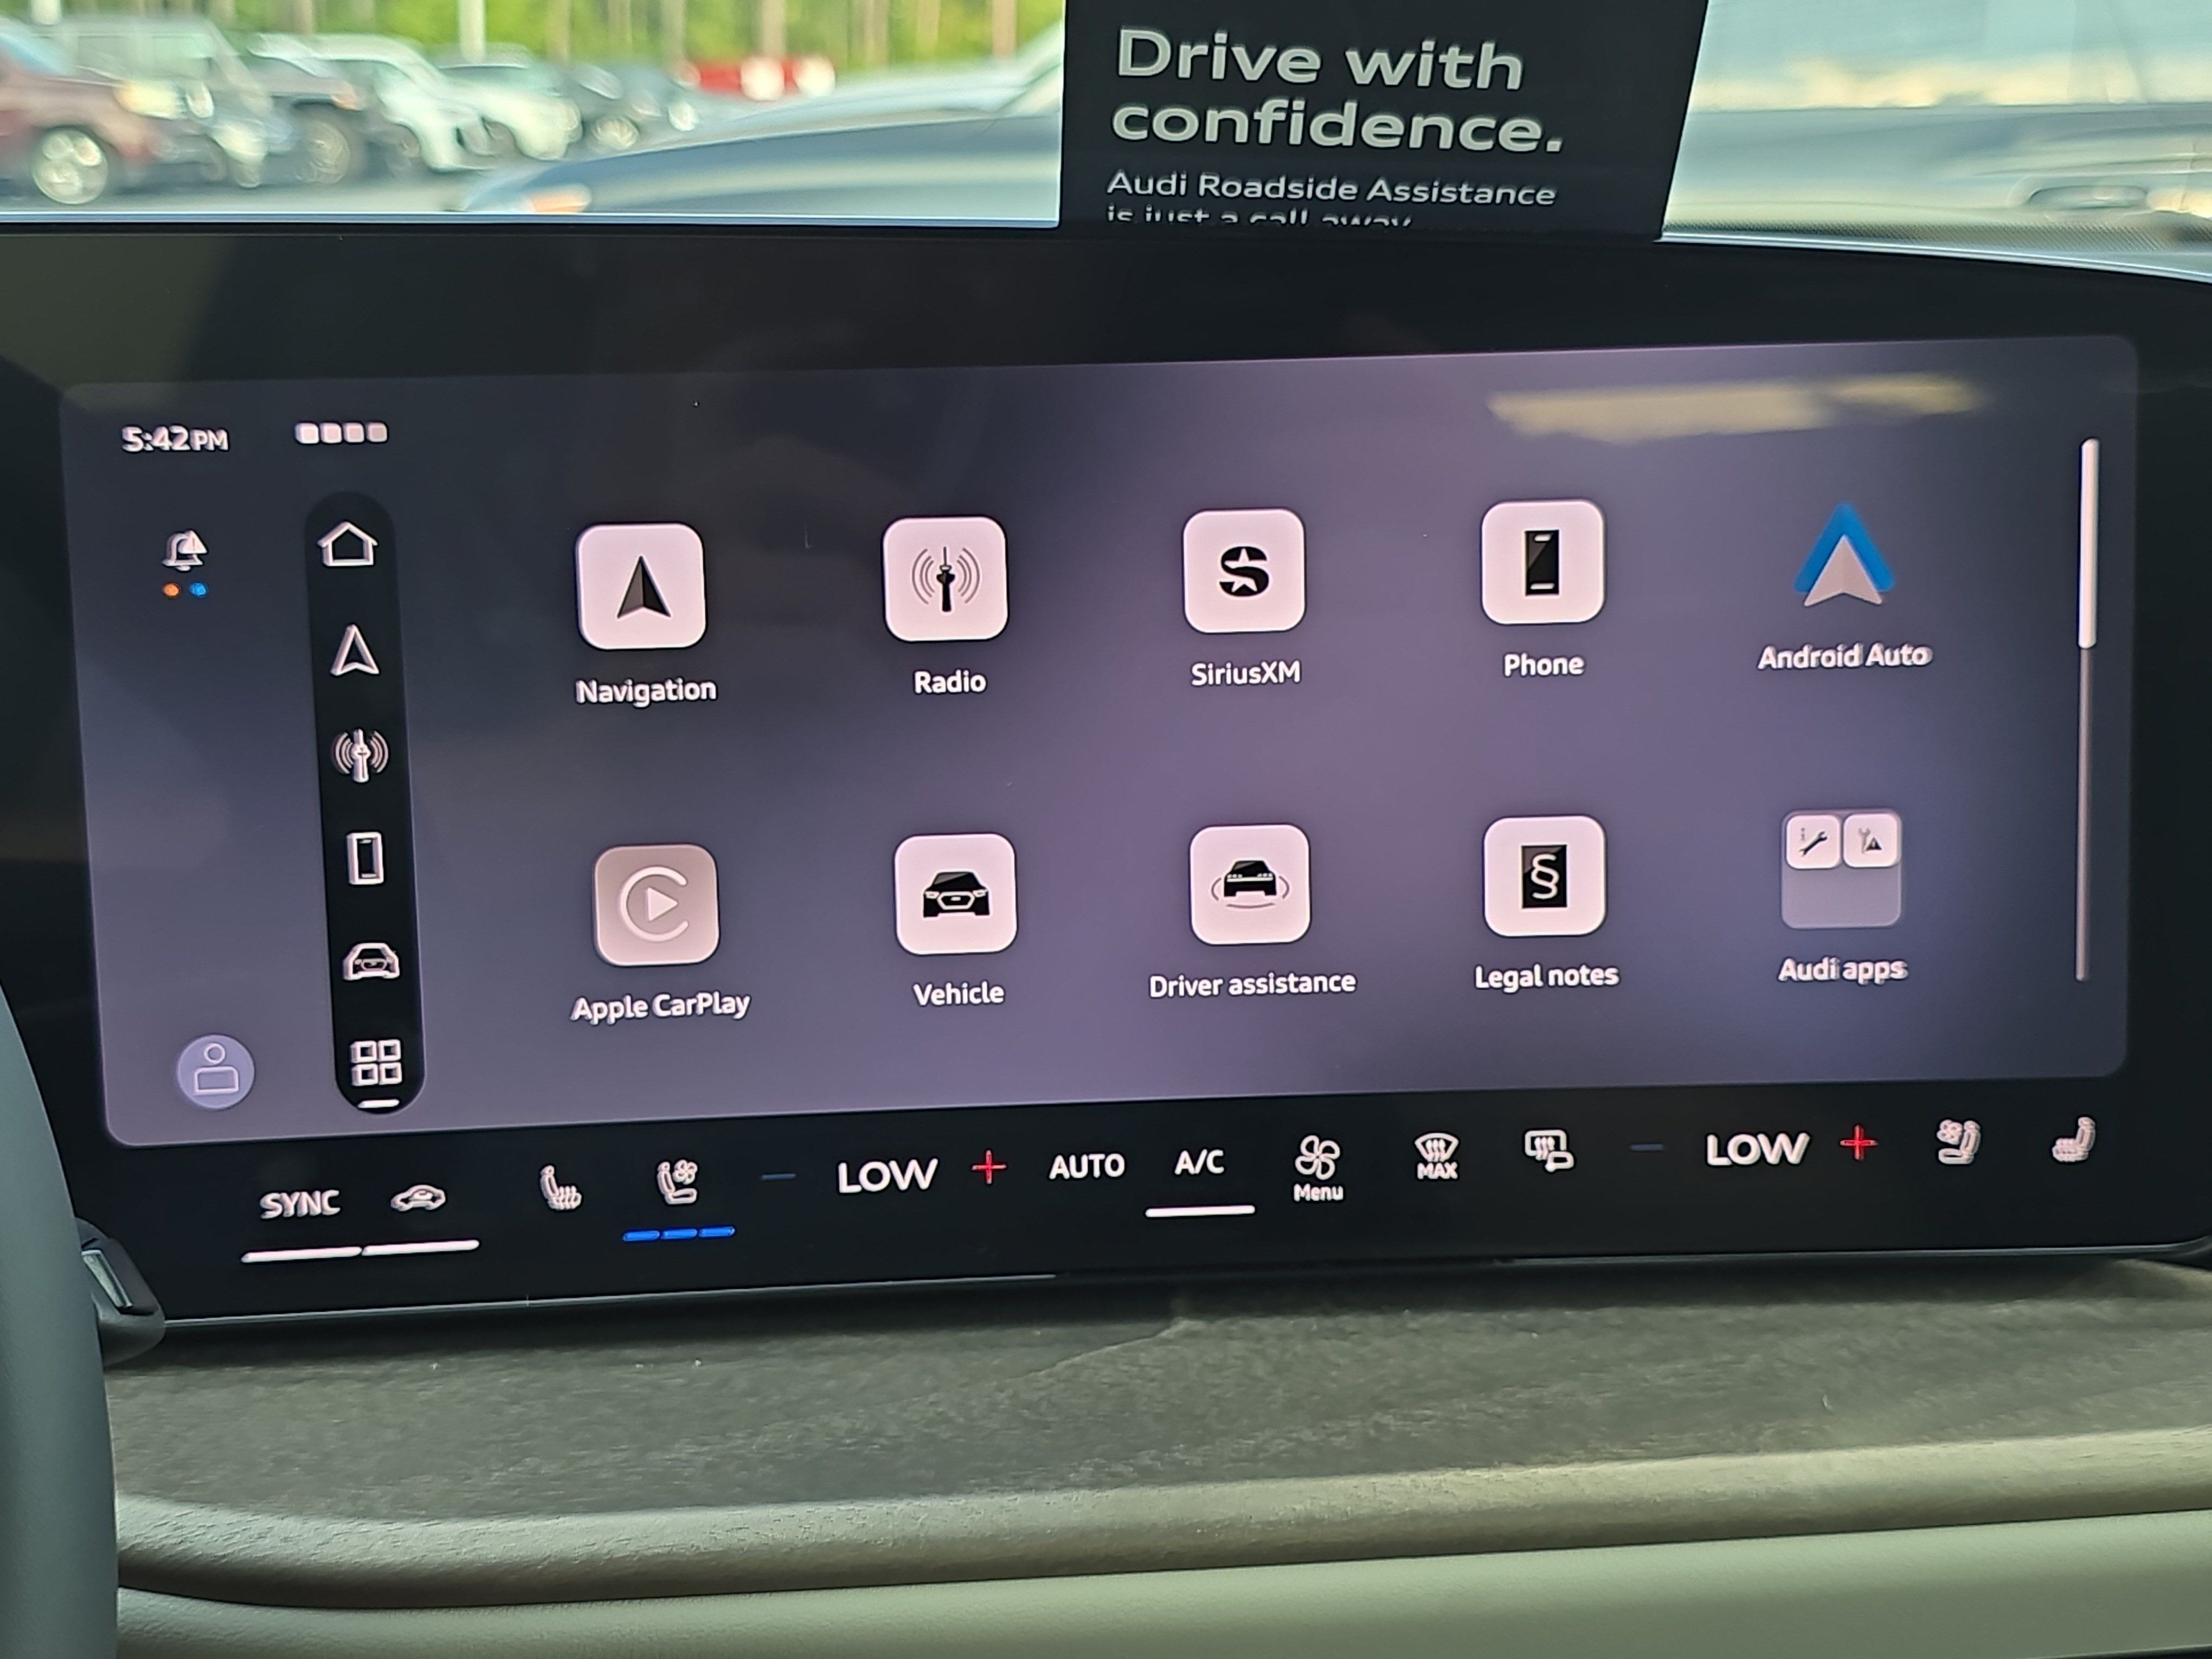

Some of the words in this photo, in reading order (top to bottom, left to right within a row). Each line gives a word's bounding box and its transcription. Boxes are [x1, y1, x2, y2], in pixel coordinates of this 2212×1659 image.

[1118, 28, 1321, 83] Drive
[1345, 39, 1522, 91] with
[1112, 98, 1562, 152] confidence.
[1107, 171, 1187, 196] Audi
[1198, 172, 1358, 201] Roadside
[1366, 178, 1556, 205] Assistance
[1504, 652, 1585, 677] Phone
[1757, 642, 1863, 670] Android
[1864, 642, 1932, 667] Auto
[914, 669, 987, 694] Radio
[1191, 660, 1301, 686] SiriusXM
[575, 677, 717, 708] Navigation
[1475, 963, 1544, 994] Legal
[1548, 964, 1620, 987] notes
[1778, 956, 1840, 982] Audi
[1842, 960, 1908, 985] apps
[912, 980, 1005, 1006] Vehicle
[1149, 974, 1224, 998] Driver
[1228, 972, 1356, 995] assistance
[570, 995, 649, 1025] Apple
[652, 991, 751, 1020] CarPlay
[1174, 1148, 1225, 1175] A/C
[1707, 1132, 1810, 1166] LOW
[838, 1158, 939, 1194] LOW
[1049, 1153, 1126, 1180] AUTO
[1417, 1162, 1458, 1180] MAX
[260, 1189, 341, 1219] SYNC
[1293, 1182, 1344, 1202] Menu
